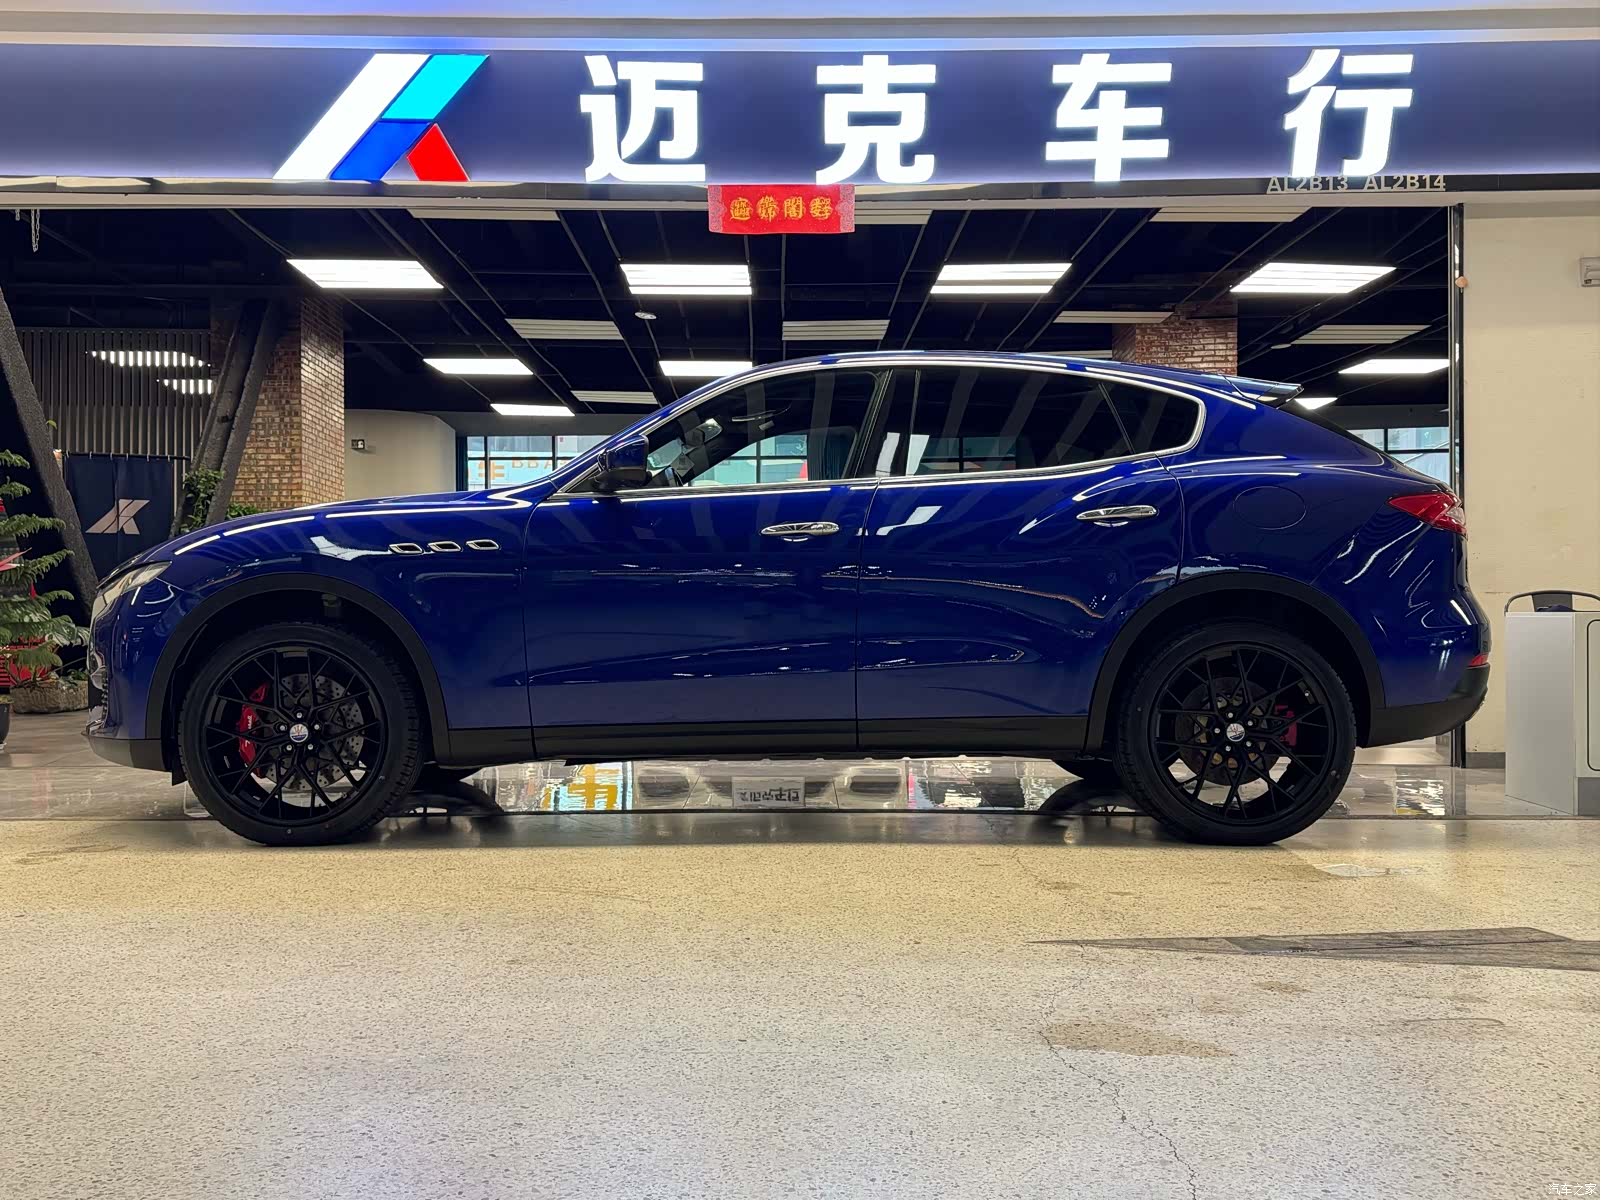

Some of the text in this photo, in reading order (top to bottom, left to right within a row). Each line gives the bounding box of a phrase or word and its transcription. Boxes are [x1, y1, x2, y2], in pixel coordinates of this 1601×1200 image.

[580, 48, 1413, 184] 迈克车行
[1266, 174, 1447, 194] AL2B13 AL2B14
